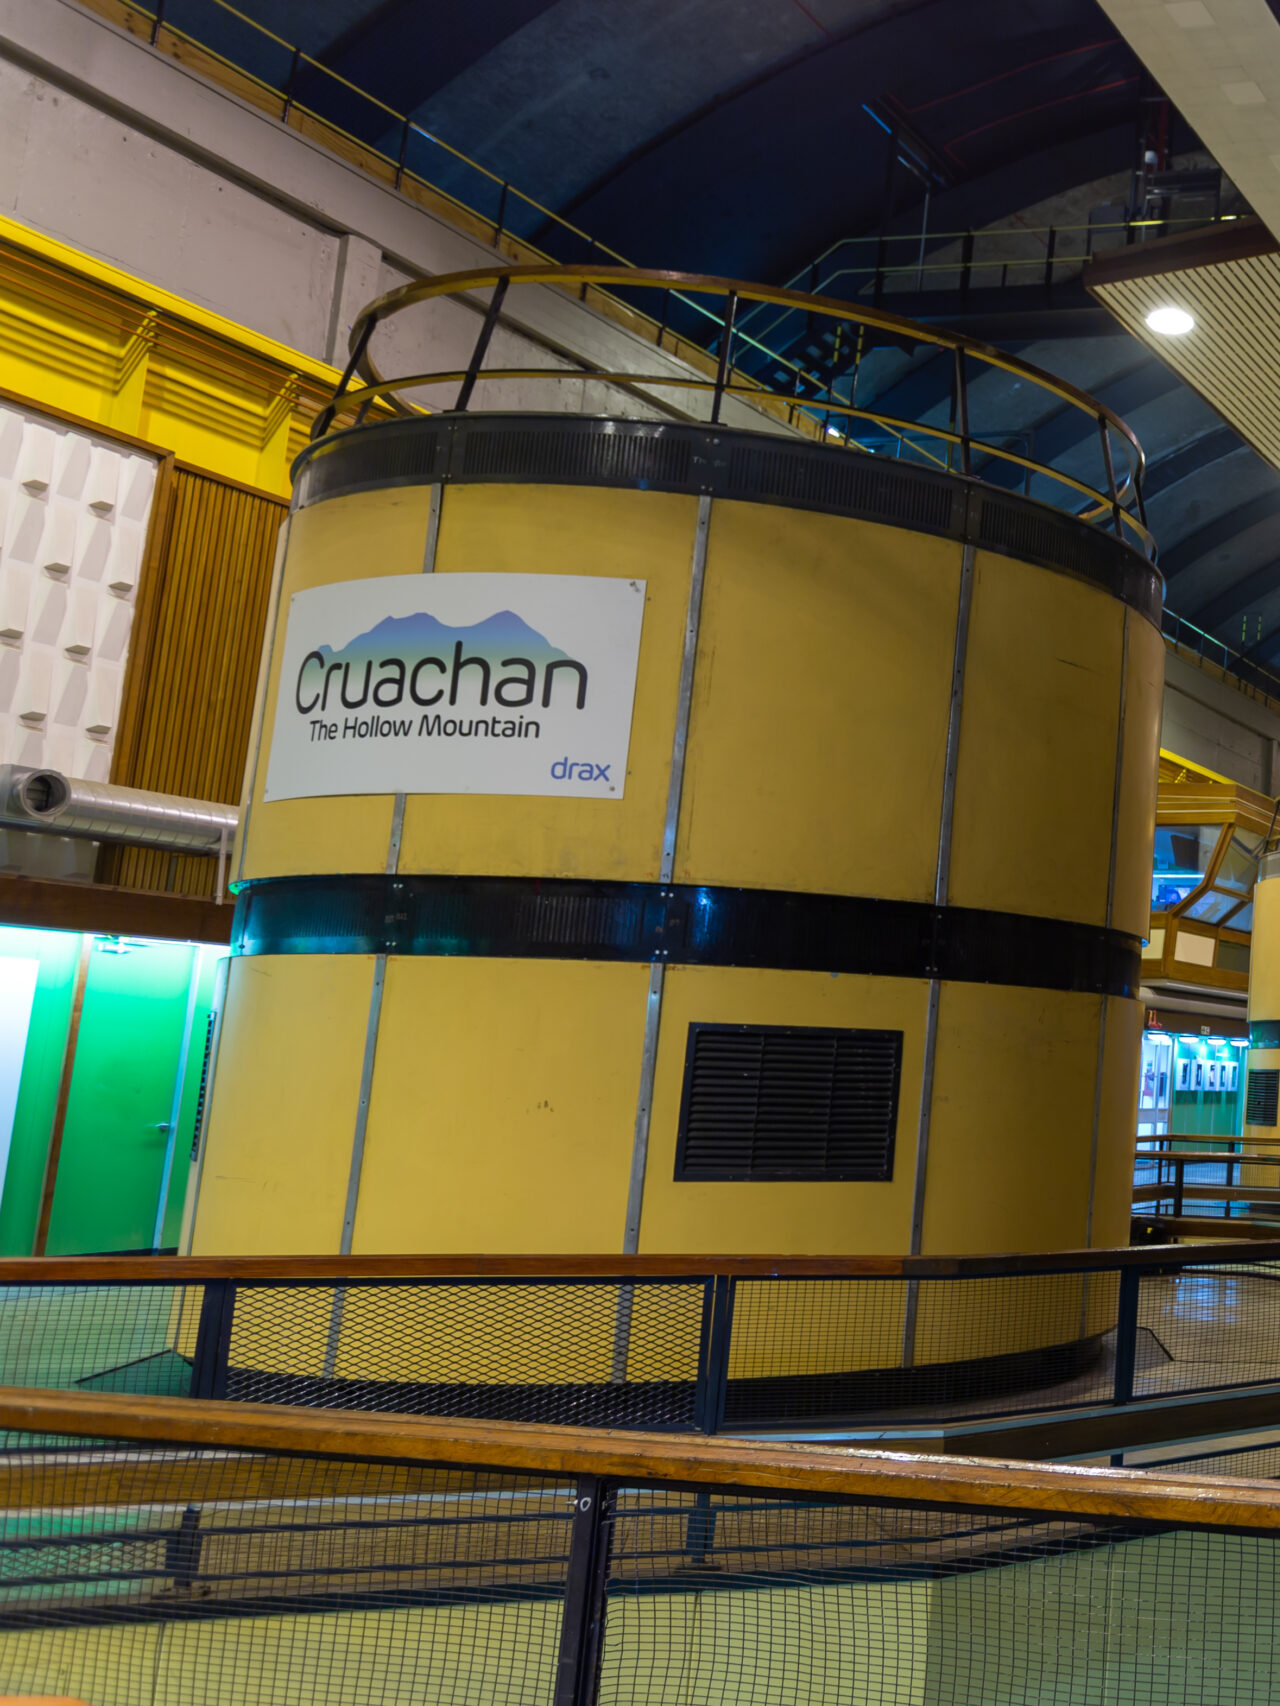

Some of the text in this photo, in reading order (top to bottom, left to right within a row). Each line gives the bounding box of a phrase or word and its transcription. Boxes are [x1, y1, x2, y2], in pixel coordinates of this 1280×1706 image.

[296, 640, 588, 714] Cruachan
[310, 713, 541, 742] The Hollow Mountain
[550, 756, 611, 782] drax
